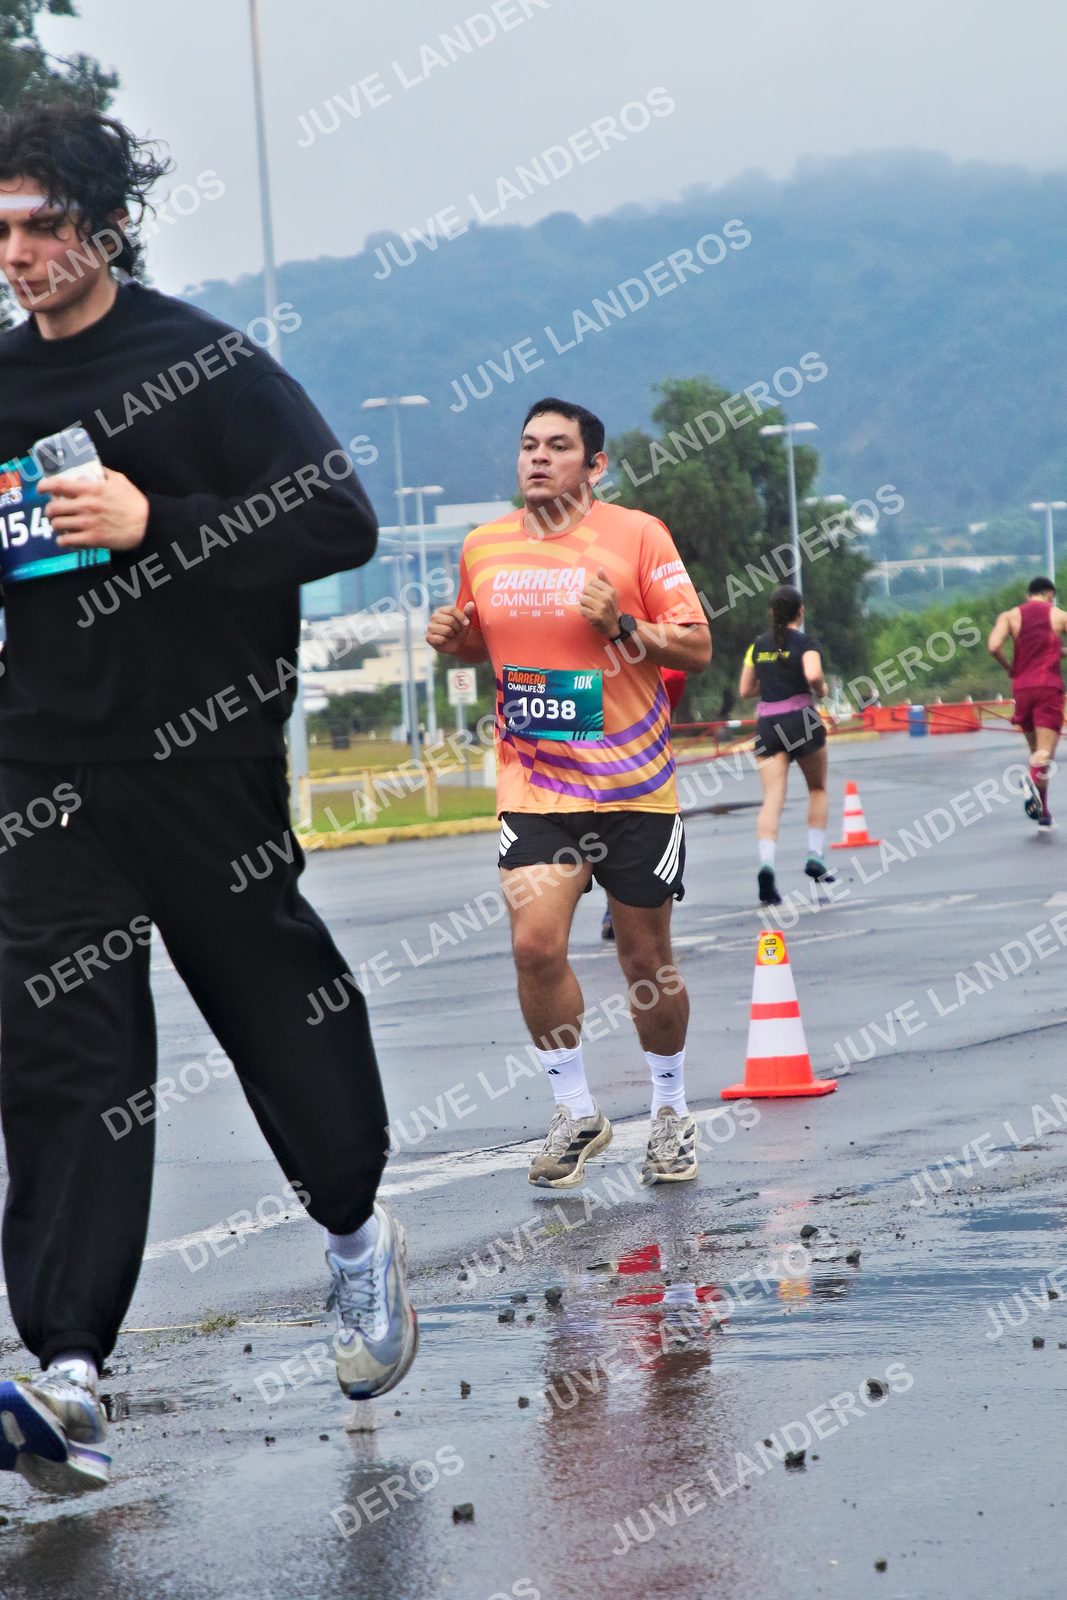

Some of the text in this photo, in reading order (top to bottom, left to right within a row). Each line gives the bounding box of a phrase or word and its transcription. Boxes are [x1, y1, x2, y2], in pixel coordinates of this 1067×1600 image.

[492, 567, 586, 591] CARRERA
[491, 591, 563, 607] OMNILIFE
[507, 671, 547, 685] CARRERA
[573, 675, 594, 690] 10K
[507, 683, 537, 693] OMNILIFE
[518, 697, 576, 720] 1038
